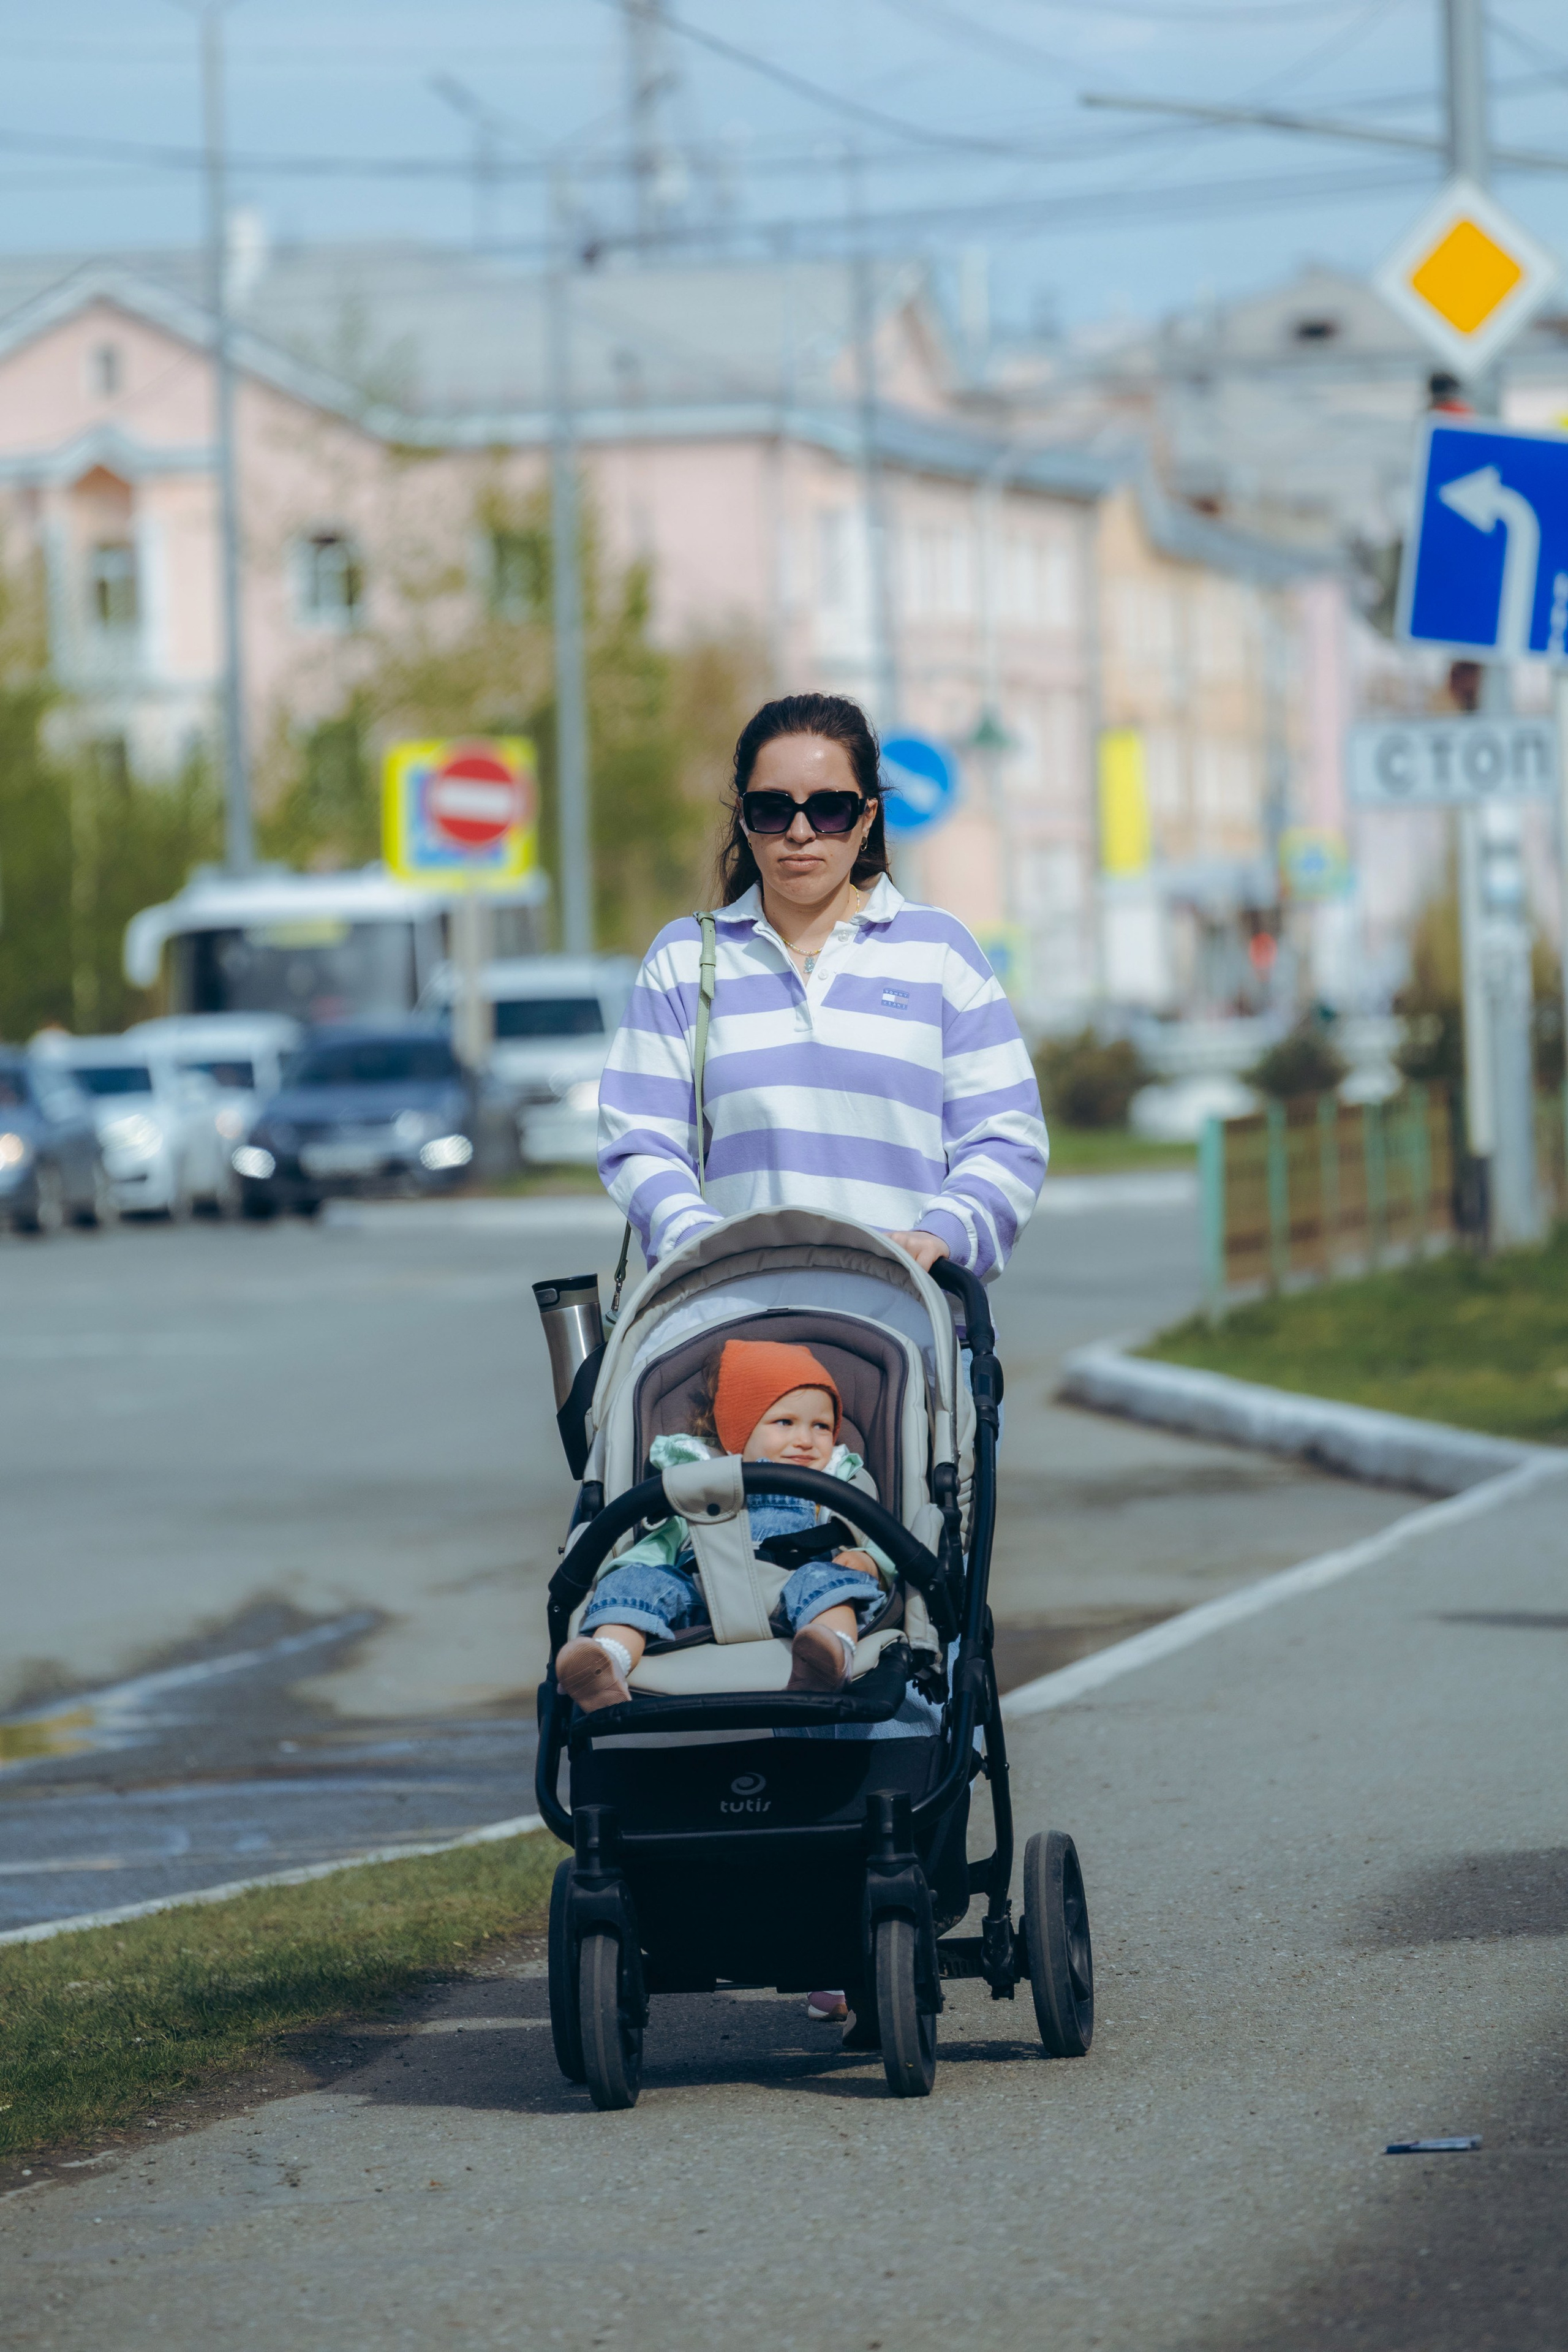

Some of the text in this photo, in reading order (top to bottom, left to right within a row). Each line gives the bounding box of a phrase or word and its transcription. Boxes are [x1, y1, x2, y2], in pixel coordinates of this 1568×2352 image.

[1375, 731, 1553, 795] СТОП
[883, 1000, 907, 1009] JEANS
[720, 1798, 771, 1813] tutis
